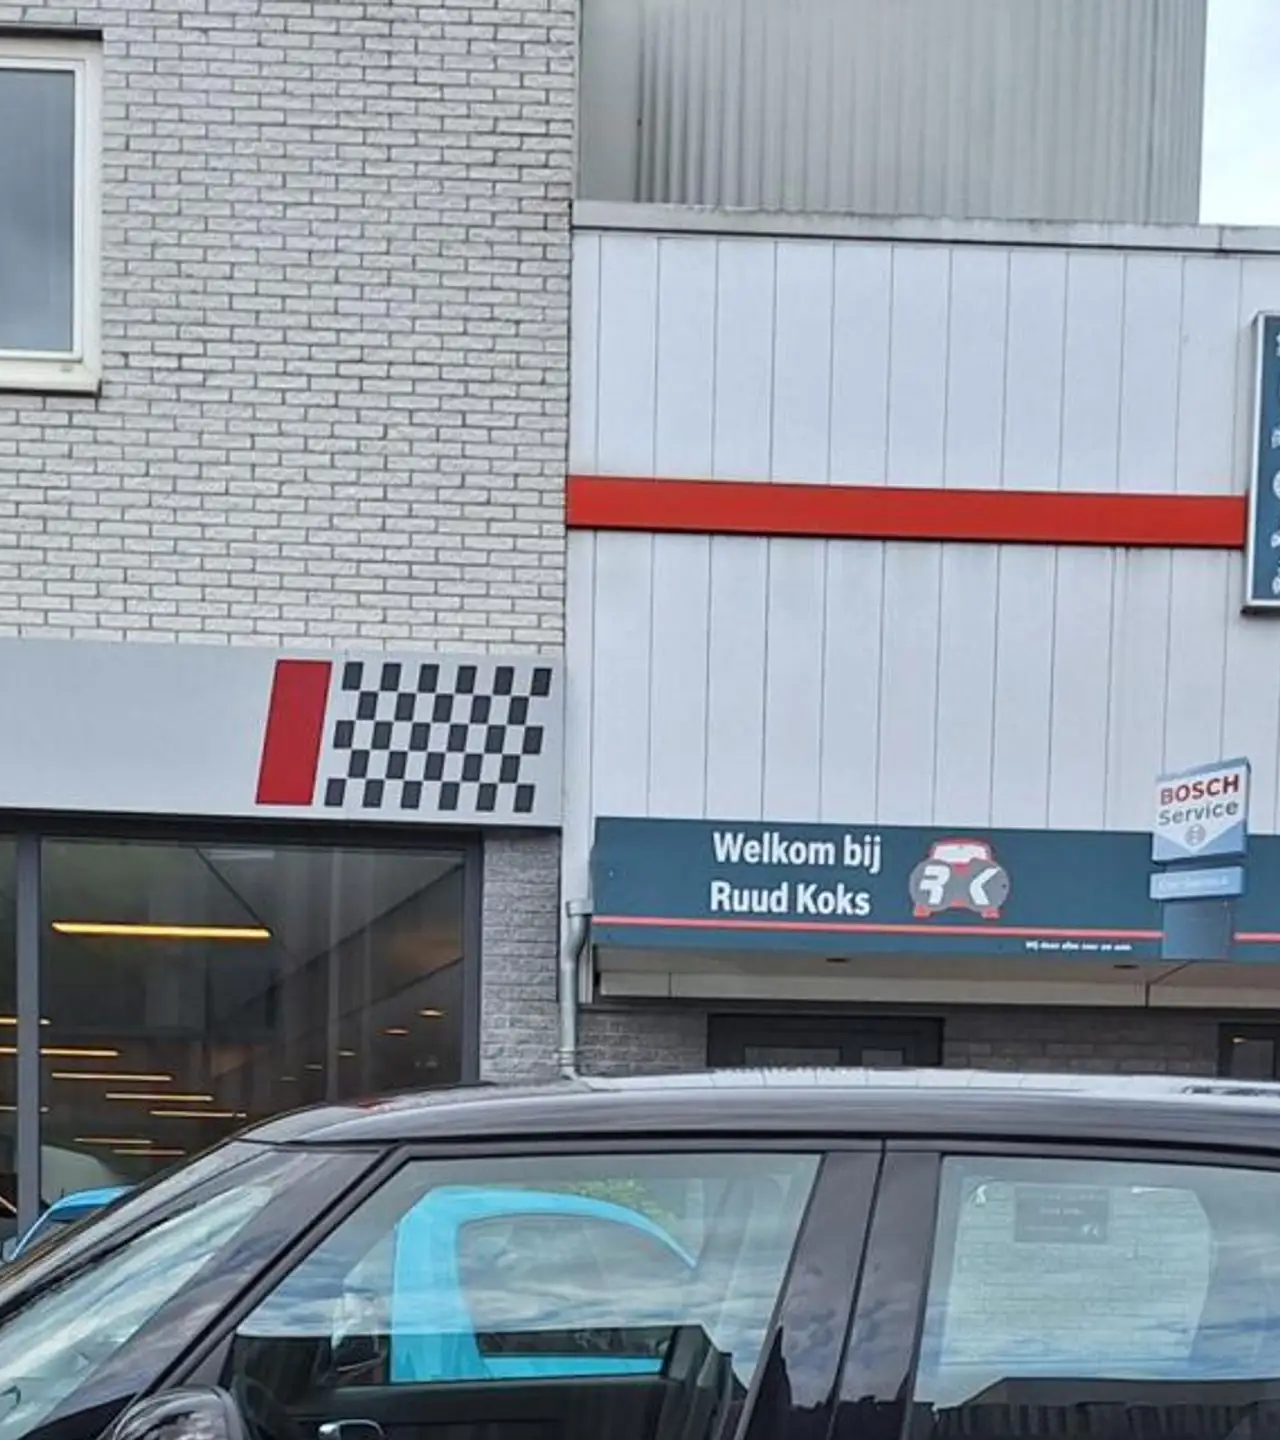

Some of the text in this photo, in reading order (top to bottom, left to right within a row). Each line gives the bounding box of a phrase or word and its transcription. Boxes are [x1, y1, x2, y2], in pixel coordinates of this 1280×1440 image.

[1160, 773, 1239, 806] BOSCH
[1158, 801, 1239, 826] Service
[712, 832, 881, 874] Welkom bij
[710, 880, 871, 916] Ruud Koks
